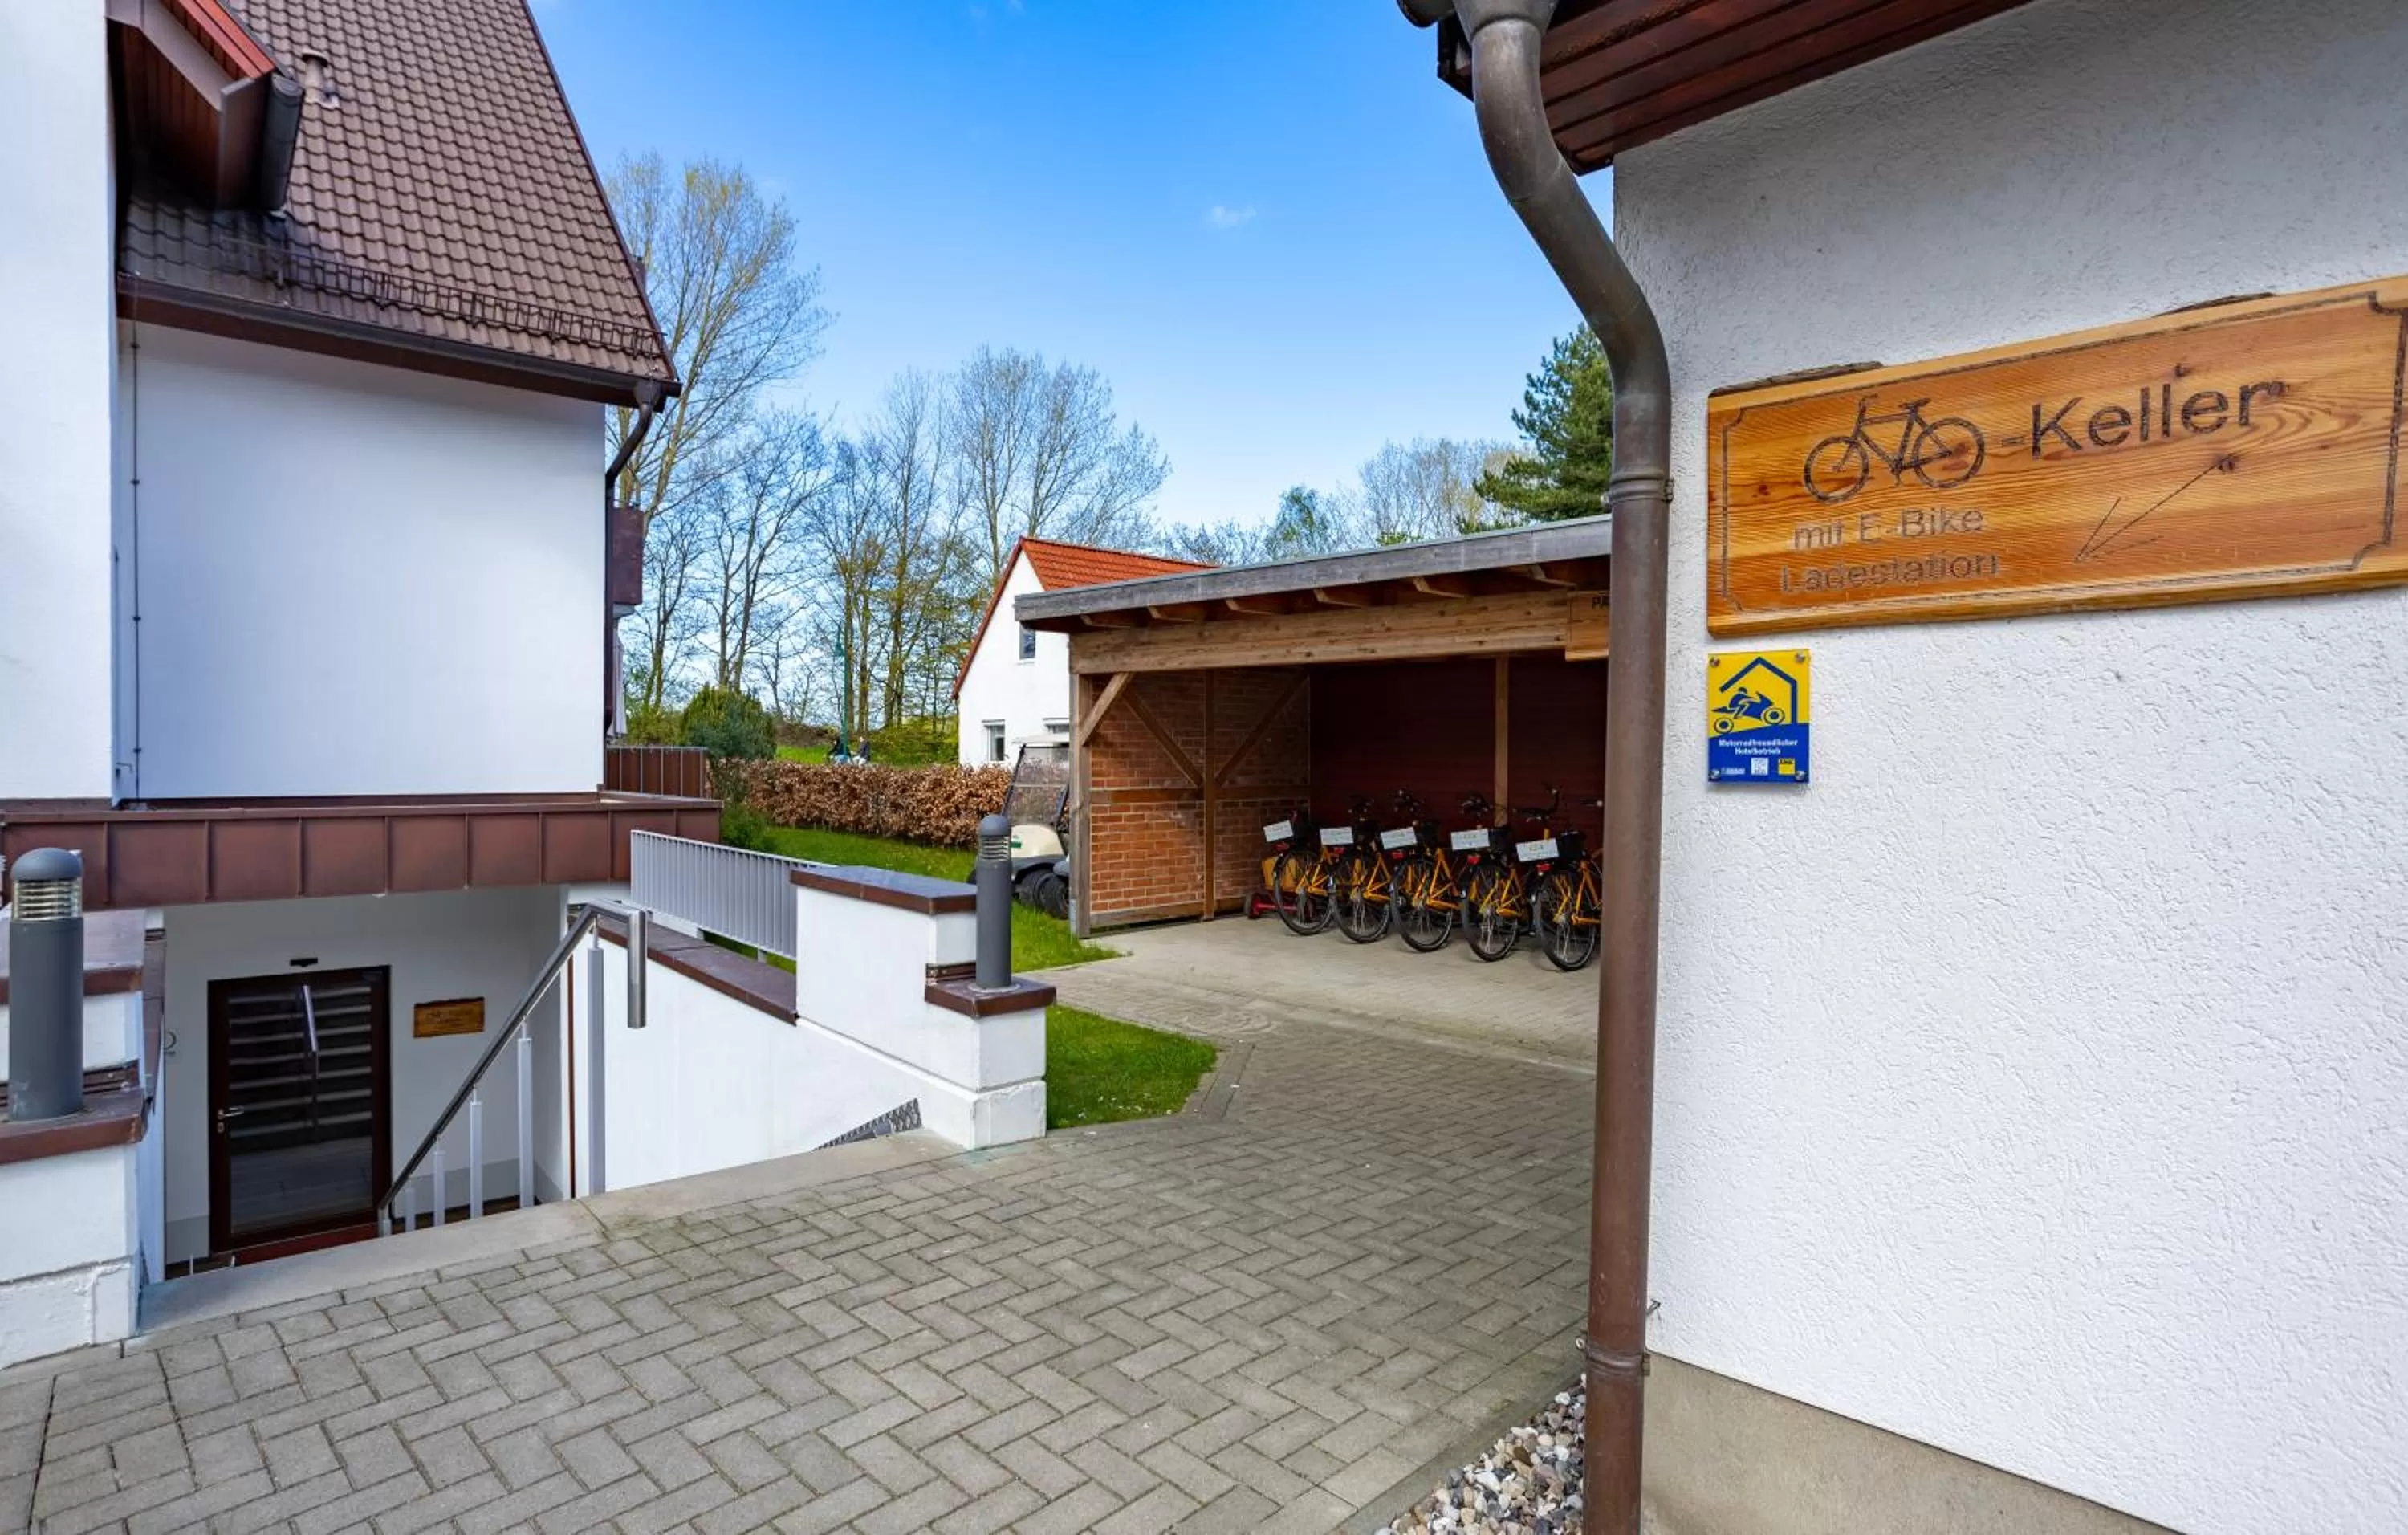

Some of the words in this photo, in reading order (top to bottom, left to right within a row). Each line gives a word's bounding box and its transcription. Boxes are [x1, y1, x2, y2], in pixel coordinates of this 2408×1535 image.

[1793, 520, 1845, 550] mit
[1859, 507, 1984, 544] E-Bike
[1780, 551, 2001, 592] Ladestation
